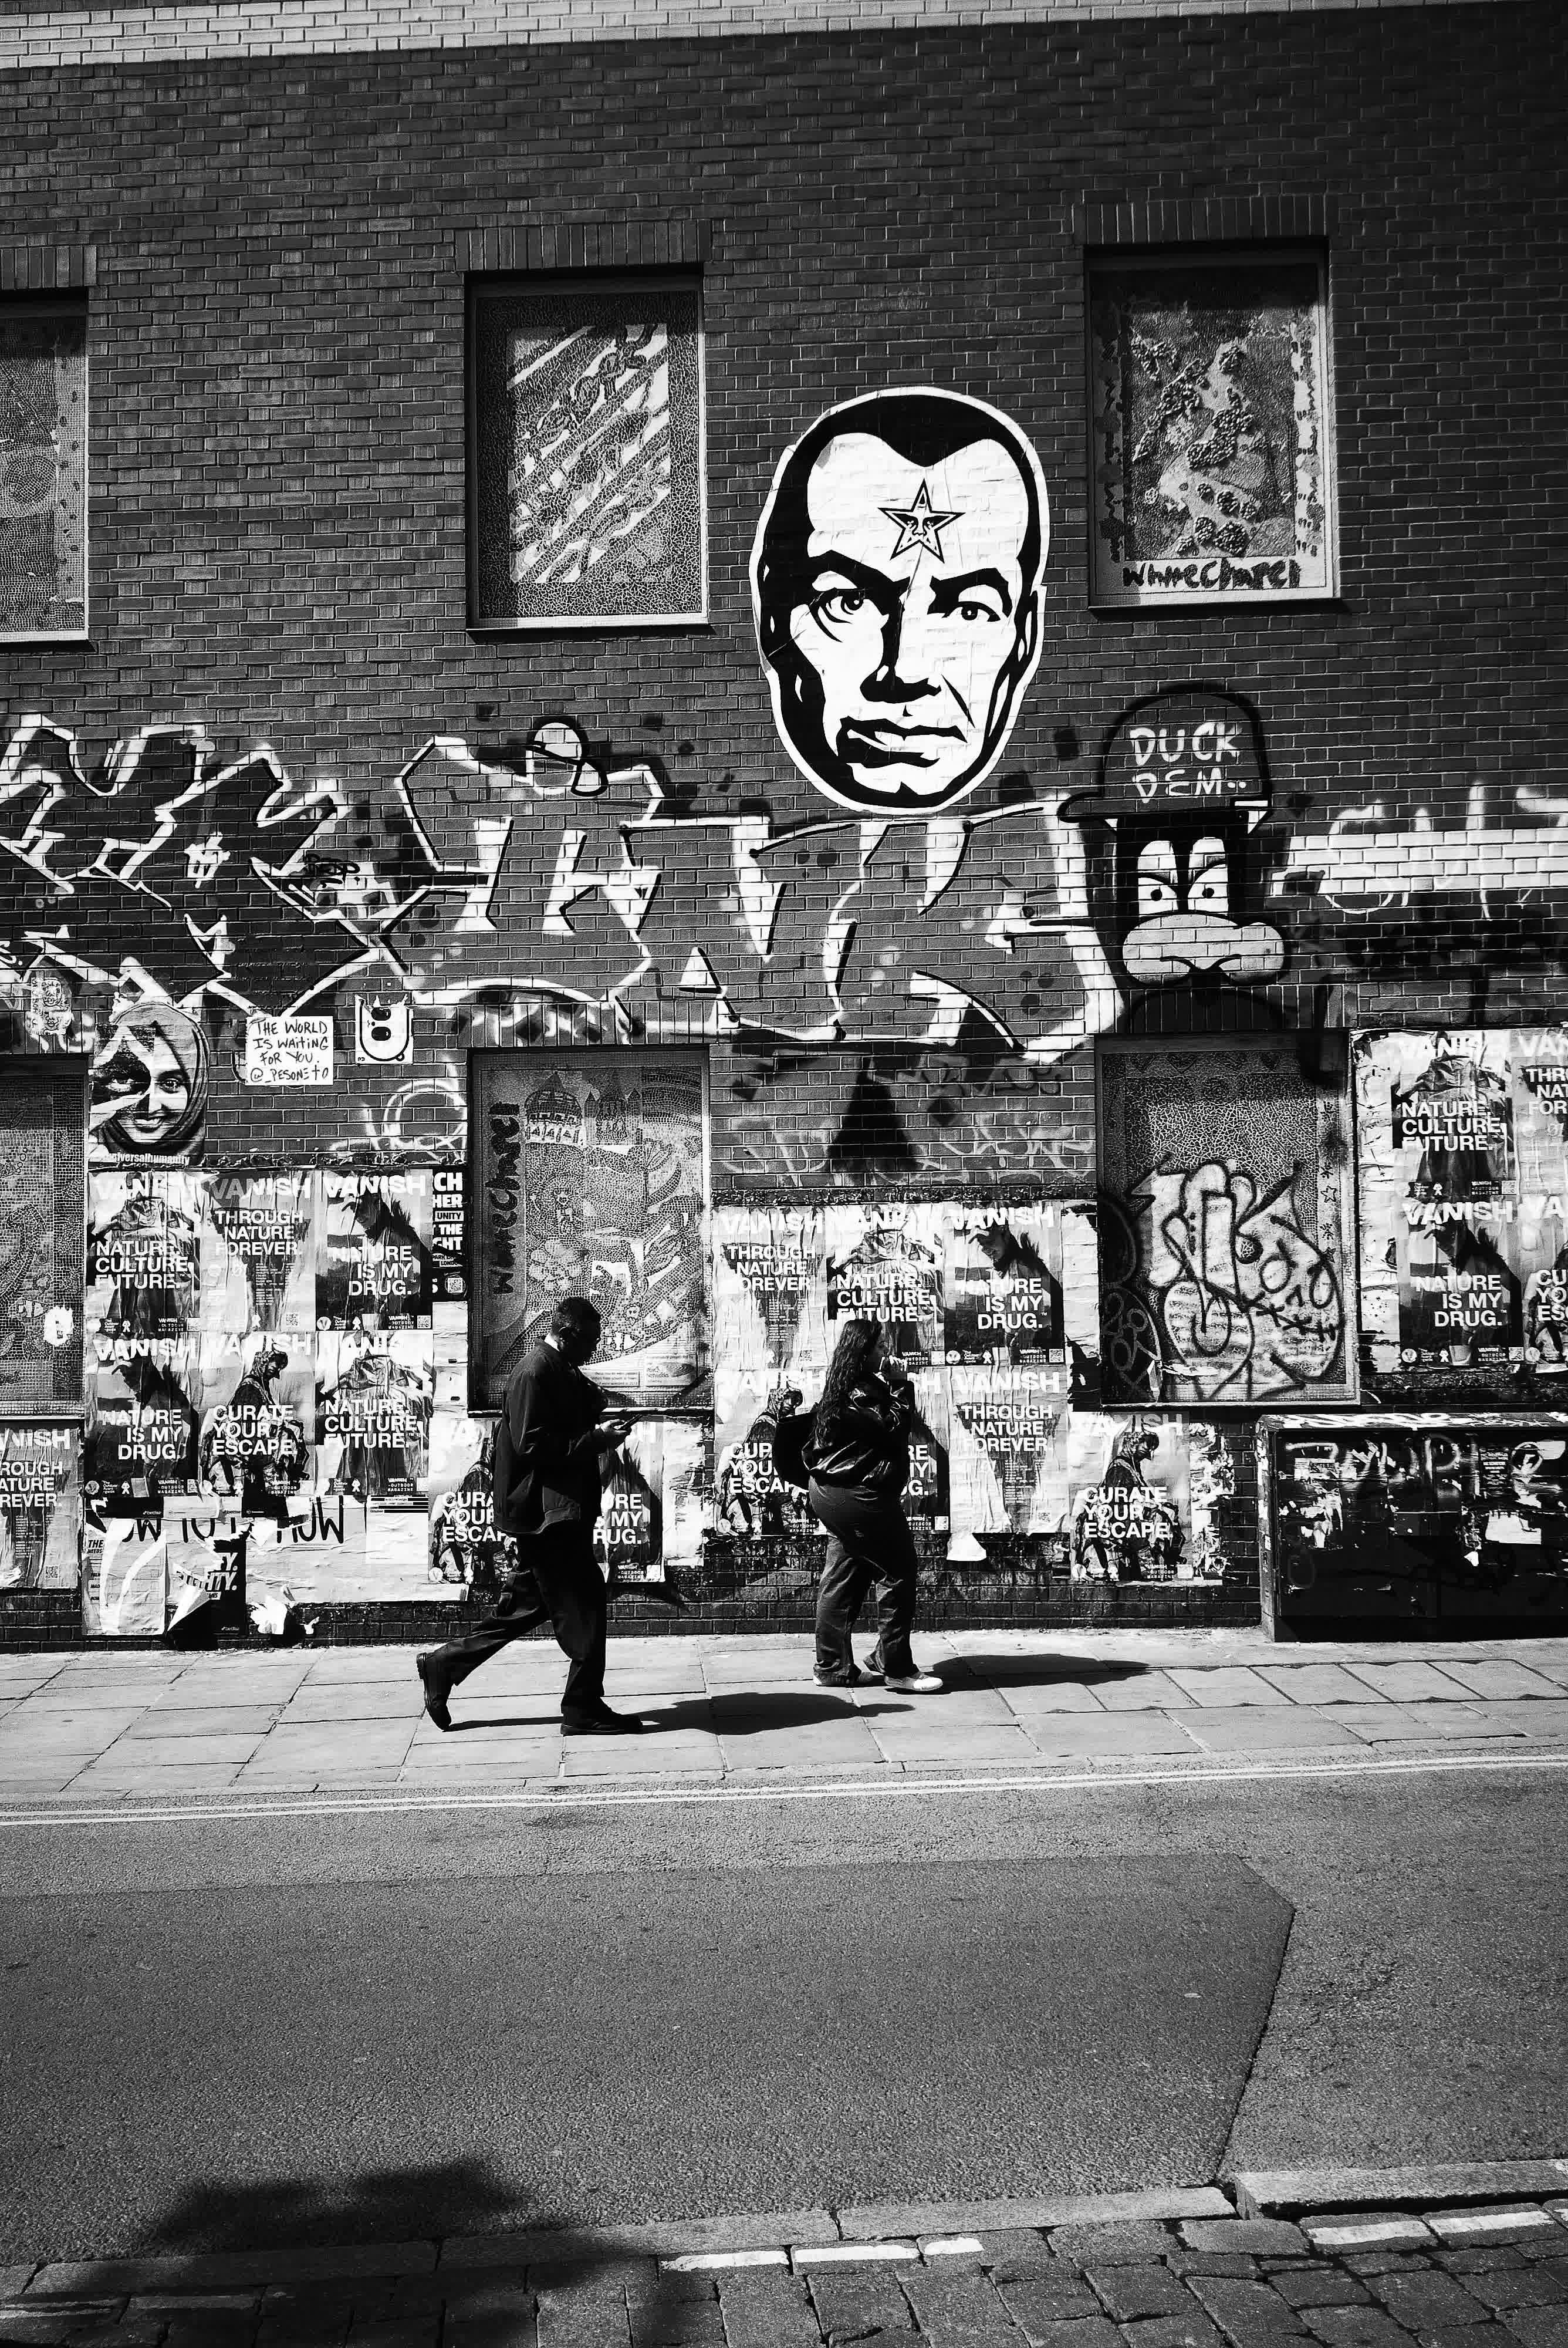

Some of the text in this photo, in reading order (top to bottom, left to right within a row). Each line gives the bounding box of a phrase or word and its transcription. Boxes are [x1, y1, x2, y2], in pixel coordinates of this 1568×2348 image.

[1130, 722, 1243, 766] DUCK
[254, 1019, 327, 1035] THE WORLD
[253, 1037, 273, 1050] IS
[260, 1051, 281, 1065] FOR
[211, 1177, 311, 1199] VANISH
[324, 1175, 426, 1198] VANISH
[432, 1172, 462, 1192] CH
[215, 1210, 303, 1224] THROUGH
[1404, 1200, 1513, 1225] VANISH
[224, 1226, 295, 1240] NATURE
[439, 1224, 463, 1235] THE
[333, 1245, 412, 1262] NATURE
[727, 1245, 816, 1260] THROUGH
[357, 1263, 413, 1278] IS MY
[736, 1261, 807, 1275] NATURE
[349, 1280, 412, 1296] DRUG.
[738, 1277, 810, 1291] OREVER
[1415, 1274, 1502, 1291] NATURE
[986, 1296, 1042, 1312] IS MY
[1442, 1293, 1502, 1310] IS MY
[978, 1313, 1043, 1329] DRUG.
[1434, 1310, 1502, 1327] DRUG.
[93, 1338, 197, 1361] VANISH
[102, 1409, 183, 1426] NATURE
[212, 1405, 294, 1421] CURATE
[961, 1405, 1052, 1419] THROUGH
[127, 1426, 183, 1443] IS MY
[212, 1423, 270, 1438] YOUR
[971, 1421, 1044, 1436] NATURE
[0, 1428, 70, 1449] NISH
[212, 1439, 298, 1455] ESCAPE.
[1086, 1486, 1167, 1503] CURATE
[611, 1511, 643, 1527] MY
[1084, 1504, 1144, 1521] YOUR
[88, 1539, 104, 1549] THE
[593, 1528, 642, 1544] RUG.
